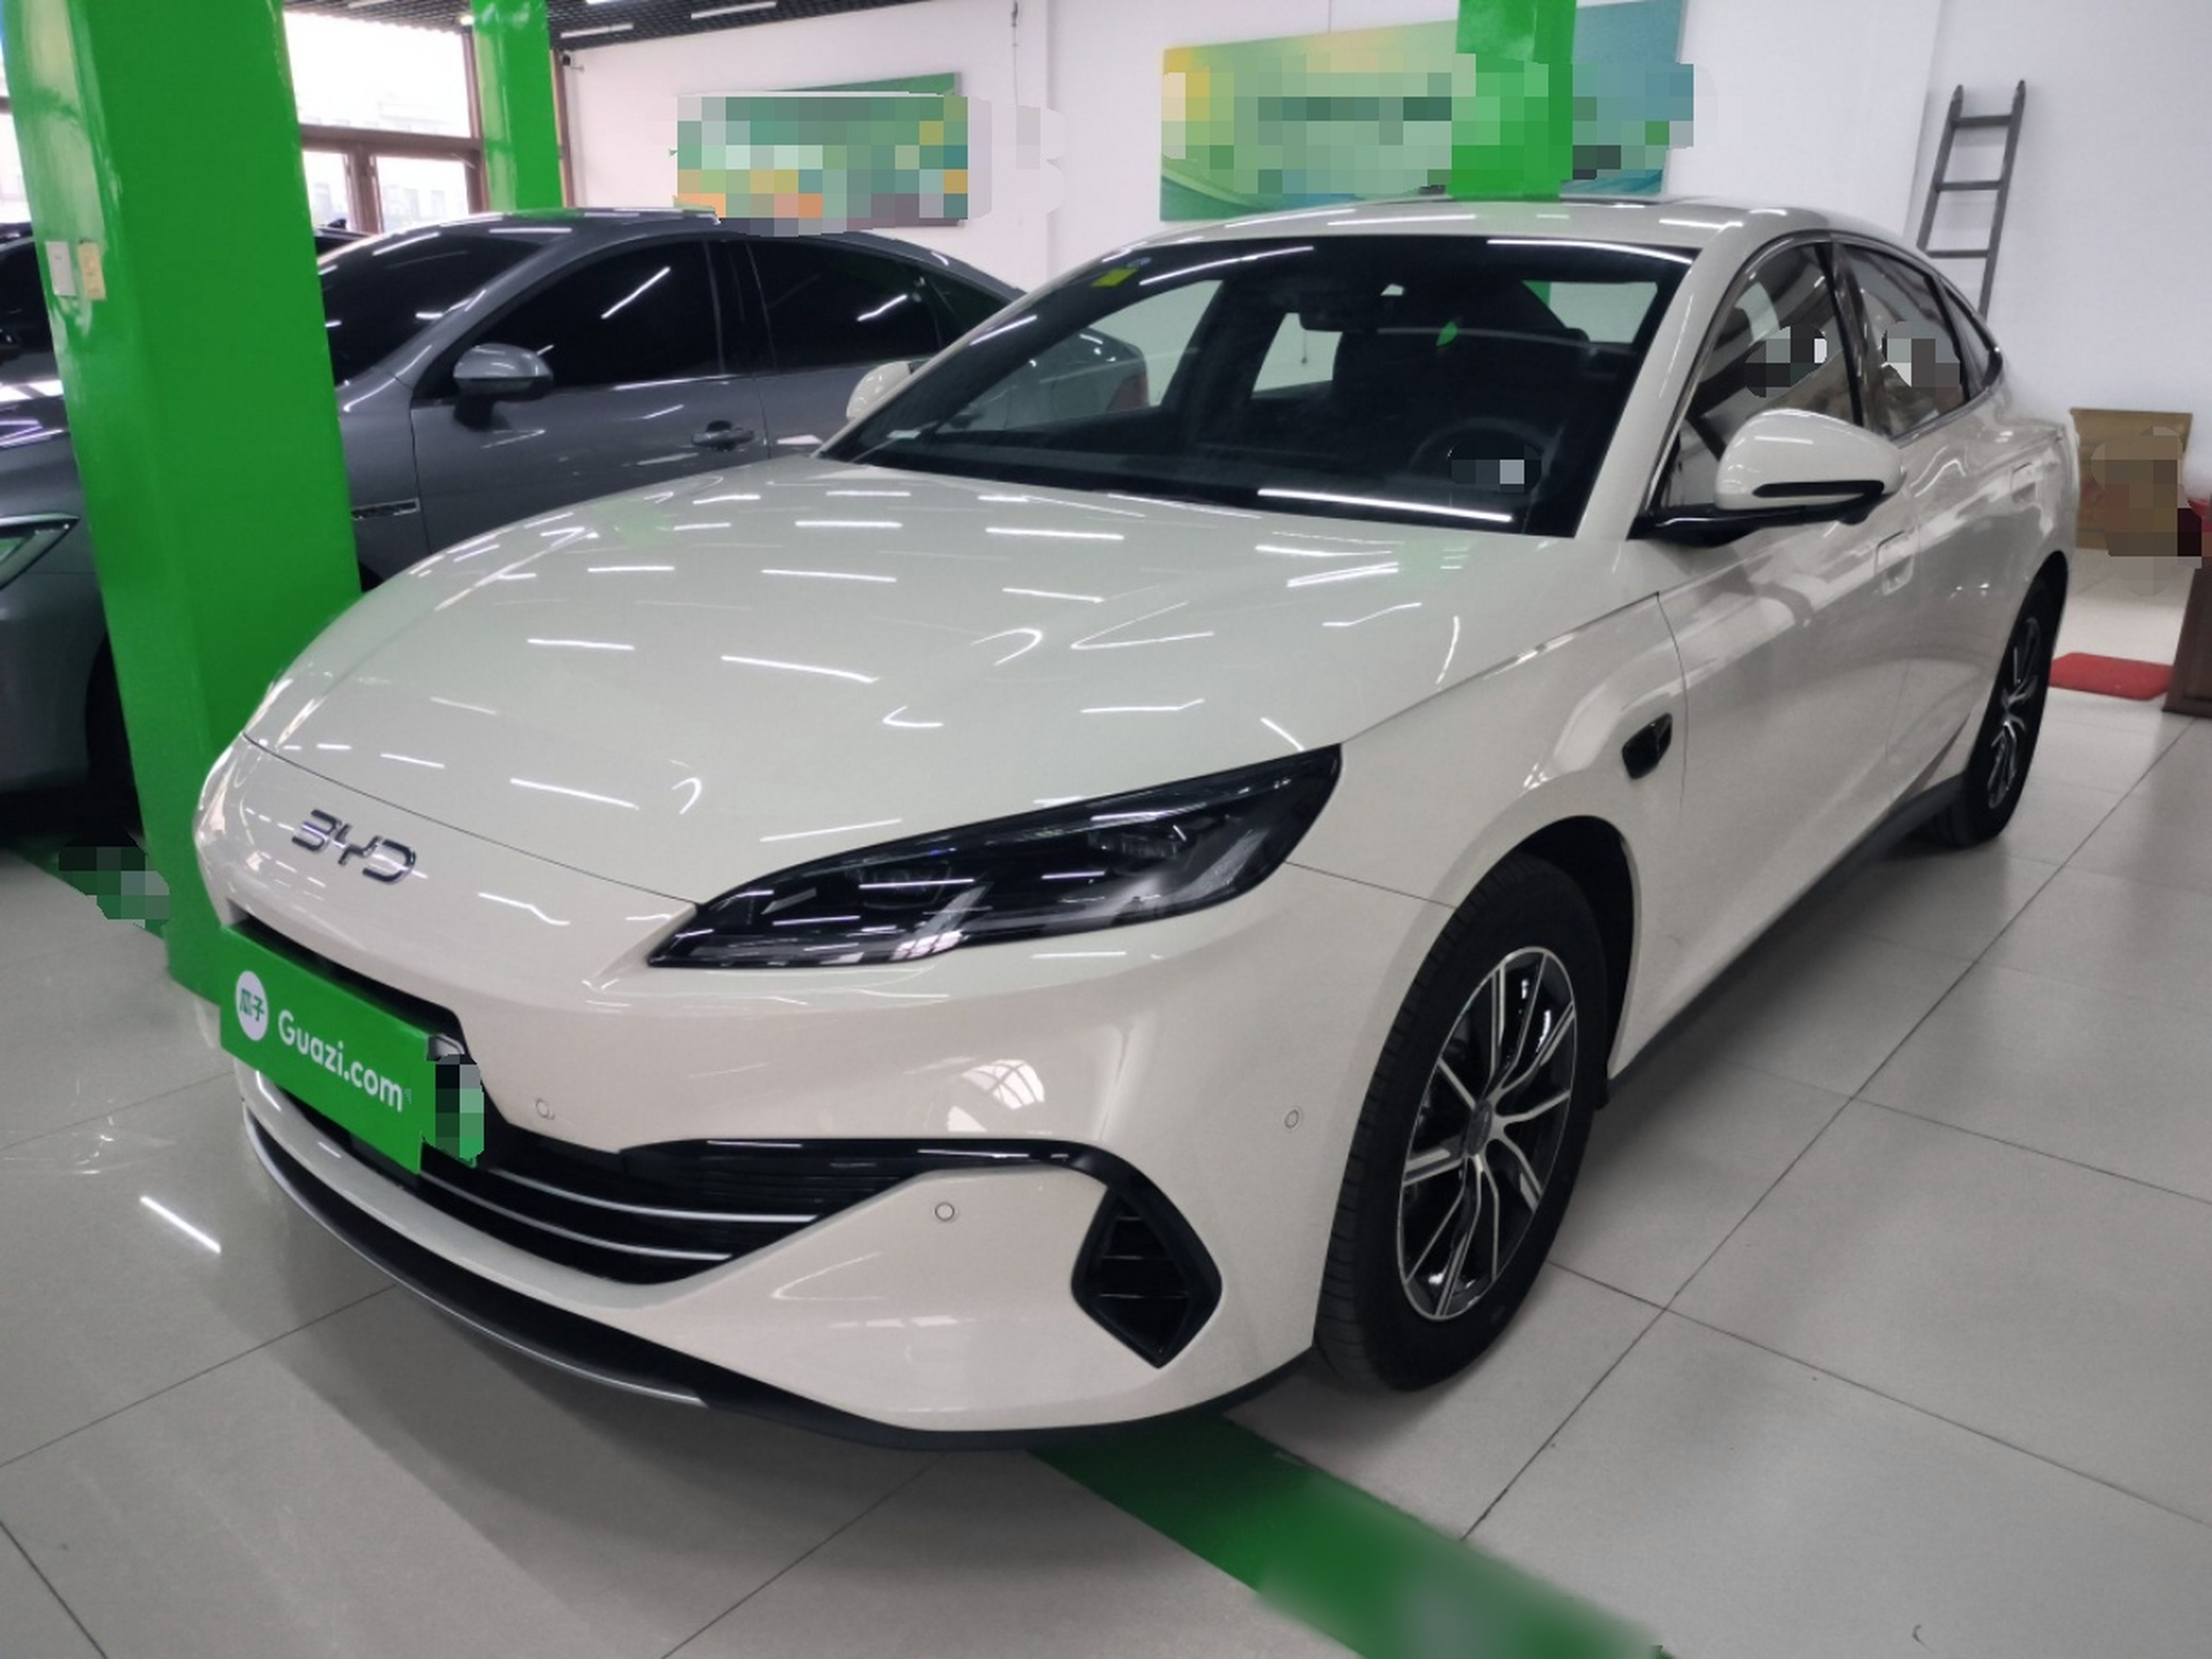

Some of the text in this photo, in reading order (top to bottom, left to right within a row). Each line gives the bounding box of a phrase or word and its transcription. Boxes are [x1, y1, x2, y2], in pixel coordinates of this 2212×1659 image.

[291, 809, 416, 884] BYD
[240, 988, 264, 1022] 瓜子
[278, 1009, 403, 1113] Guazi.com
